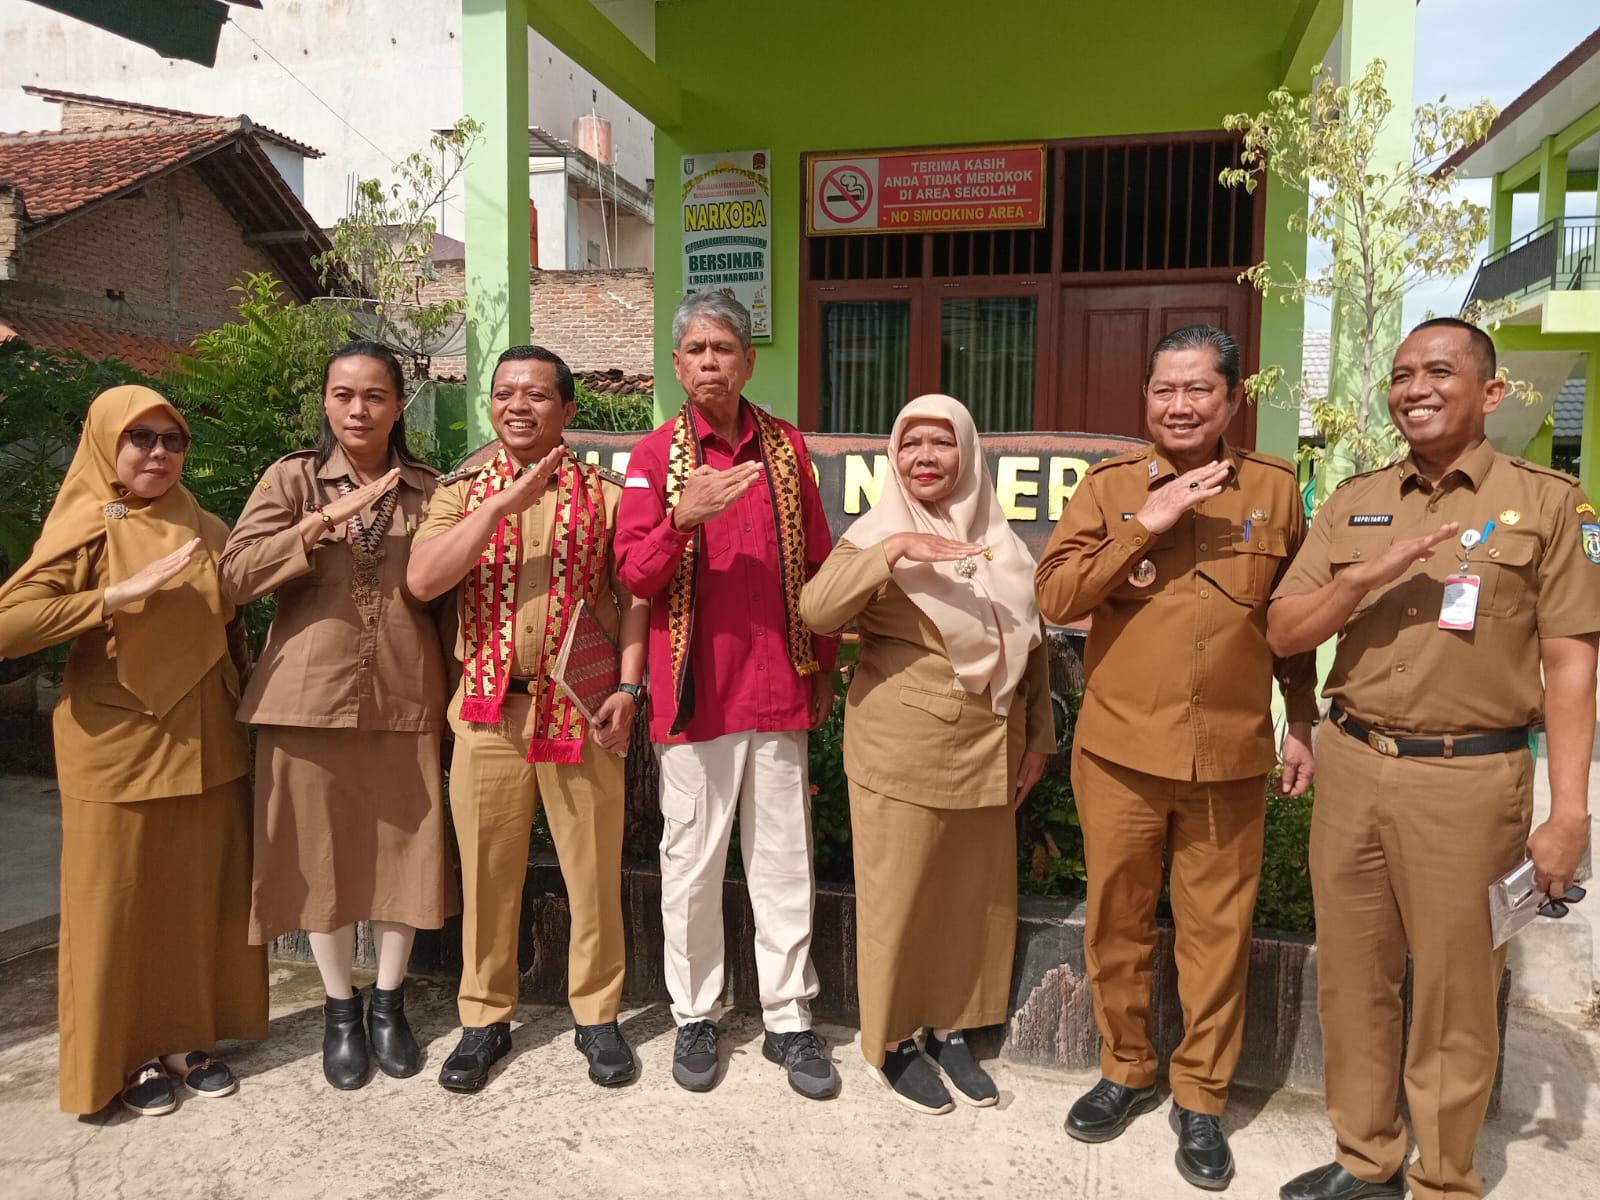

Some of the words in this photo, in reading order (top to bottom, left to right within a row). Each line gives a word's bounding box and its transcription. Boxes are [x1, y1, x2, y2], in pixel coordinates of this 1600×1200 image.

[911, 160, 960, 173] TERIMA
[964, 158, 1006, 170] KASIH
[884, 175, 920, 188] ANDA
[923, 173, 962, 186] TIDAK
[966, 170, 1033, 184] MEROKOK
[899, 189, 912, 200] DI
[916, 187, 951, 200] AREA
[954, 184, 1016, 198] SEKOLAH
[684, 200, 767, 232] NARKOBA
[891, 210, 909, 223] NO
[913, 207, 984, 222] SMOOKING
[988, 205, 1025, 219] AREA
[689, 251, 764, 271] BERSINAR
